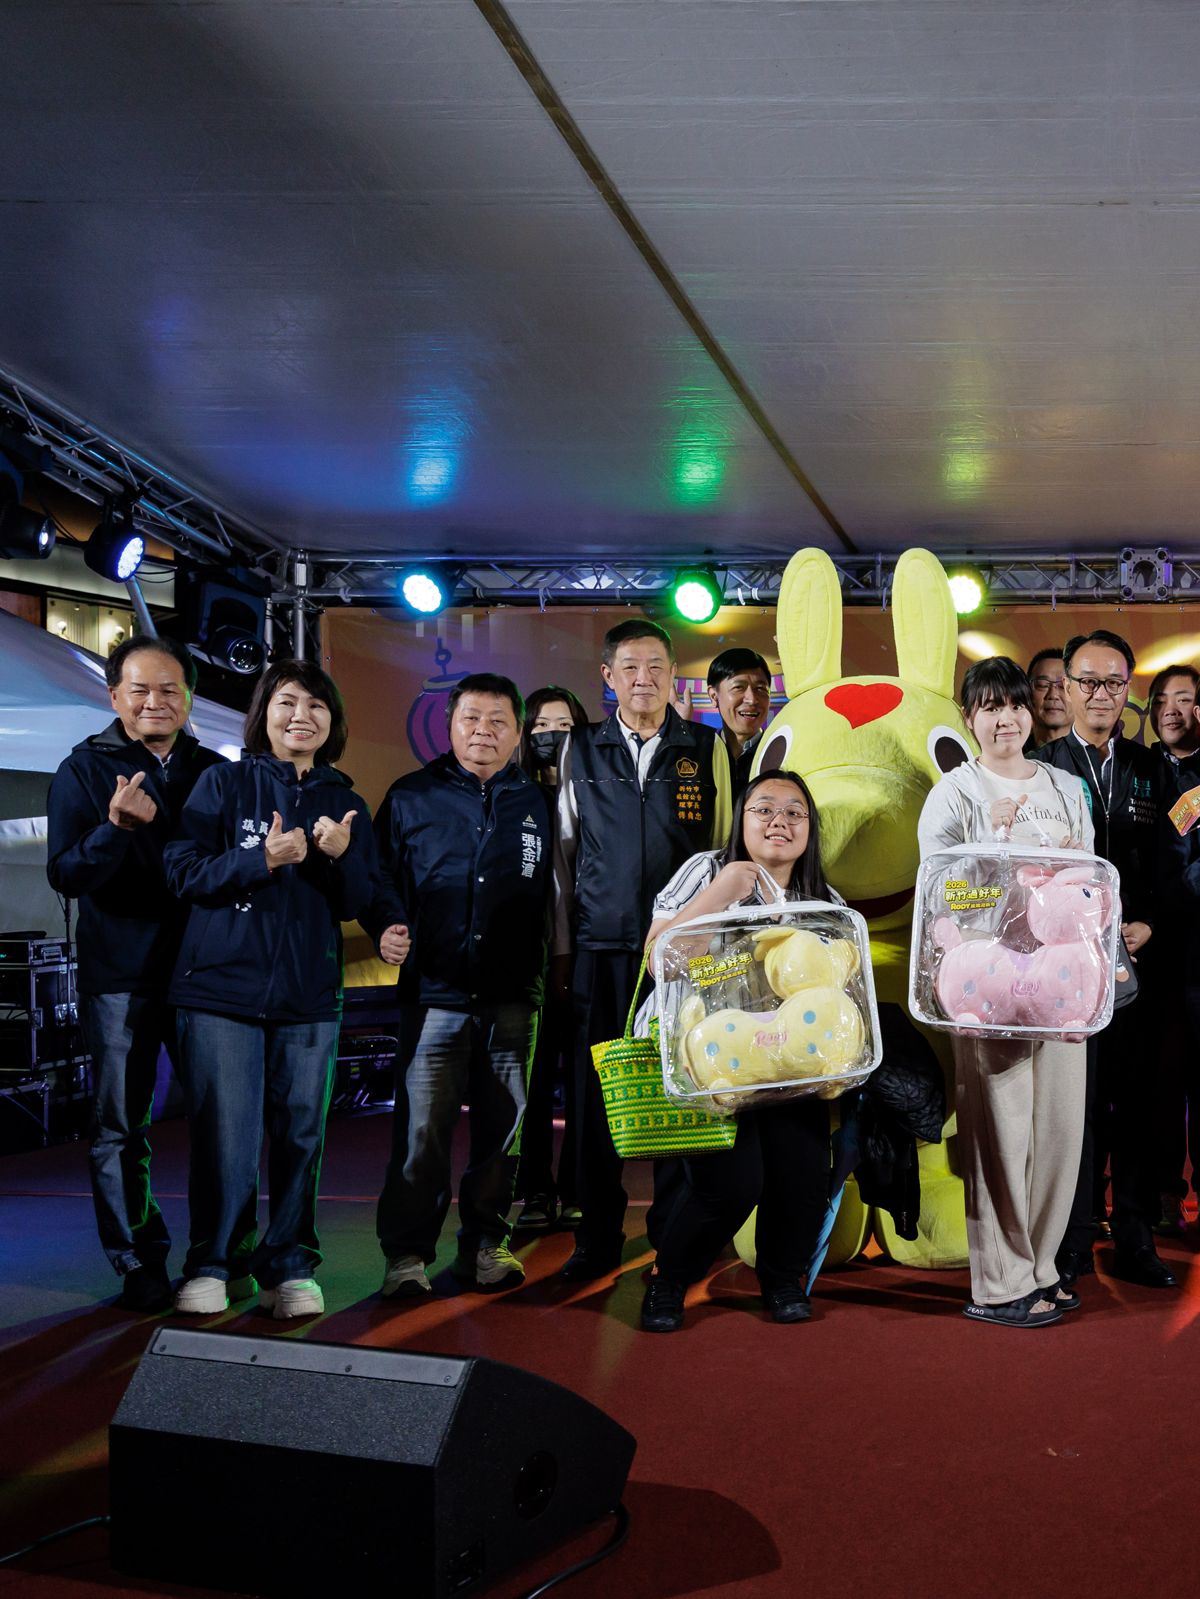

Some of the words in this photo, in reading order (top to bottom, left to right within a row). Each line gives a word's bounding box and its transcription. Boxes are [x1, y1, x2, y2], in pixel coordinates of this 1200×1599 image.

[945, 880, 968, 889] 2026
[945, 887, 1002, 901] 新竹過好年
[689, 954, 714, 968] 2026
[690, 952, 752, 979] 新竹過好年
